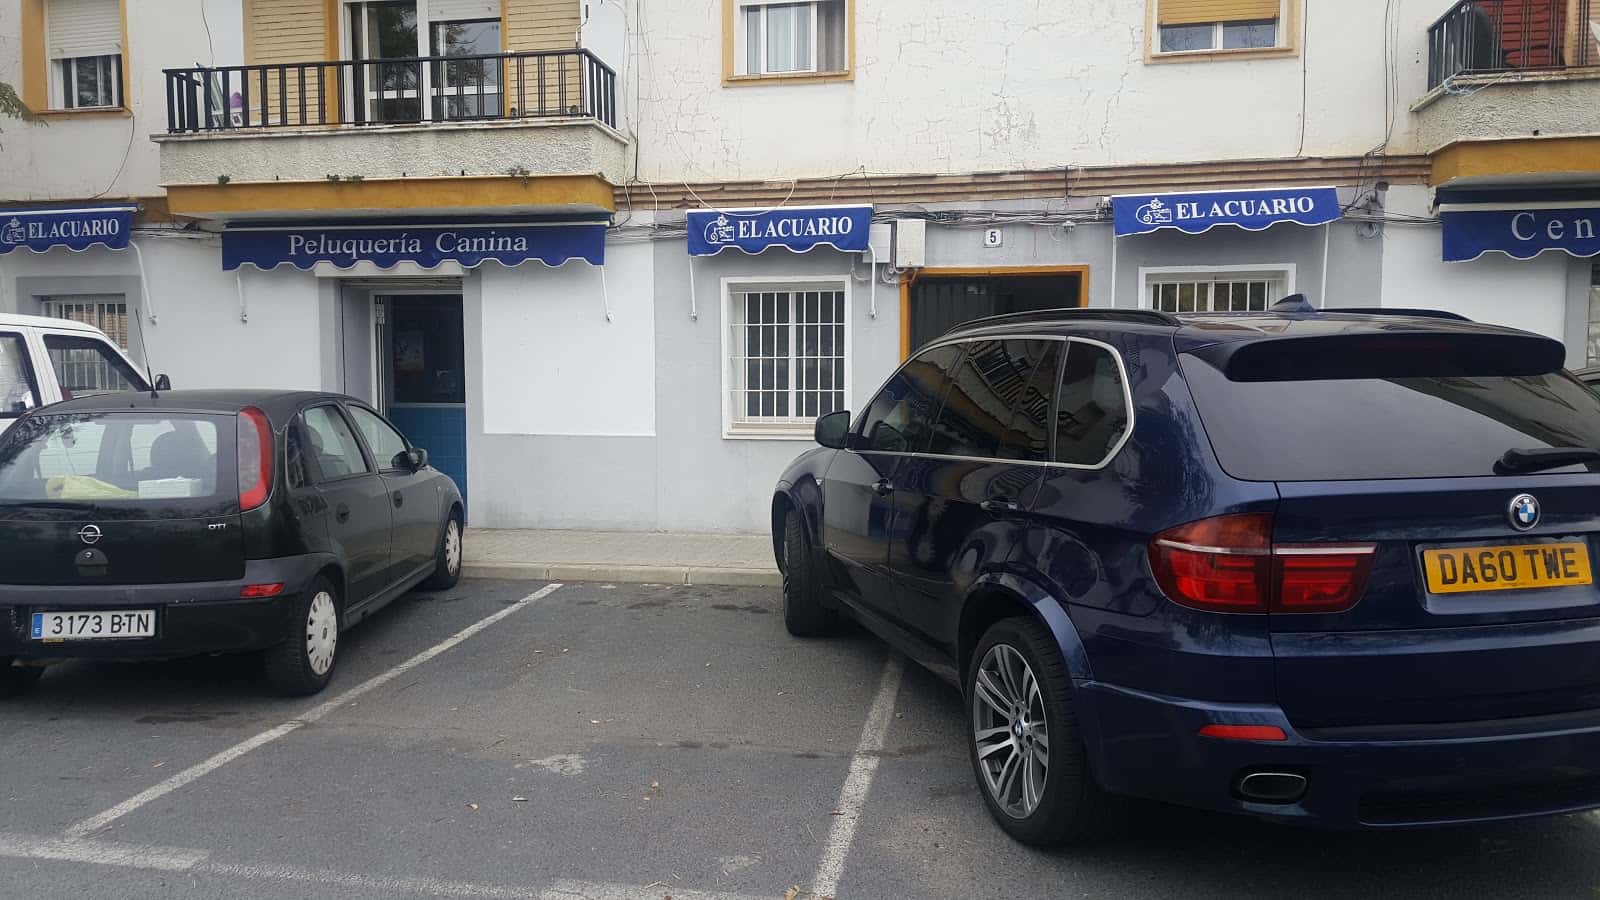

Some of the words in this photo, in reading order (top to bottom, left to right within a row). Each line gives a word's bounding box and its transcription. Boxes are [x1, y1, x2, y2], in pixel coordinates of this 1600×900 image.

[1176, 203, 1206, 220] EL
[1208, 196, 1315, 218] ACUARIO
[28, 222, 48, 239] EL
[49, 218, 120, 238] ACUARIO
[738, 220, 762, 239] EL
[764, 216, 853, 238] ACUARIO
[989, 231, 997, 244] 5
[288, 232, 423, 260] Peluquería
[435, 231, 528, 253] Canina
[1438, 550, 1518, 585] DA60
[1523, 547, 1580, 580] TWE
[51, 614, 103, 635] 3173
